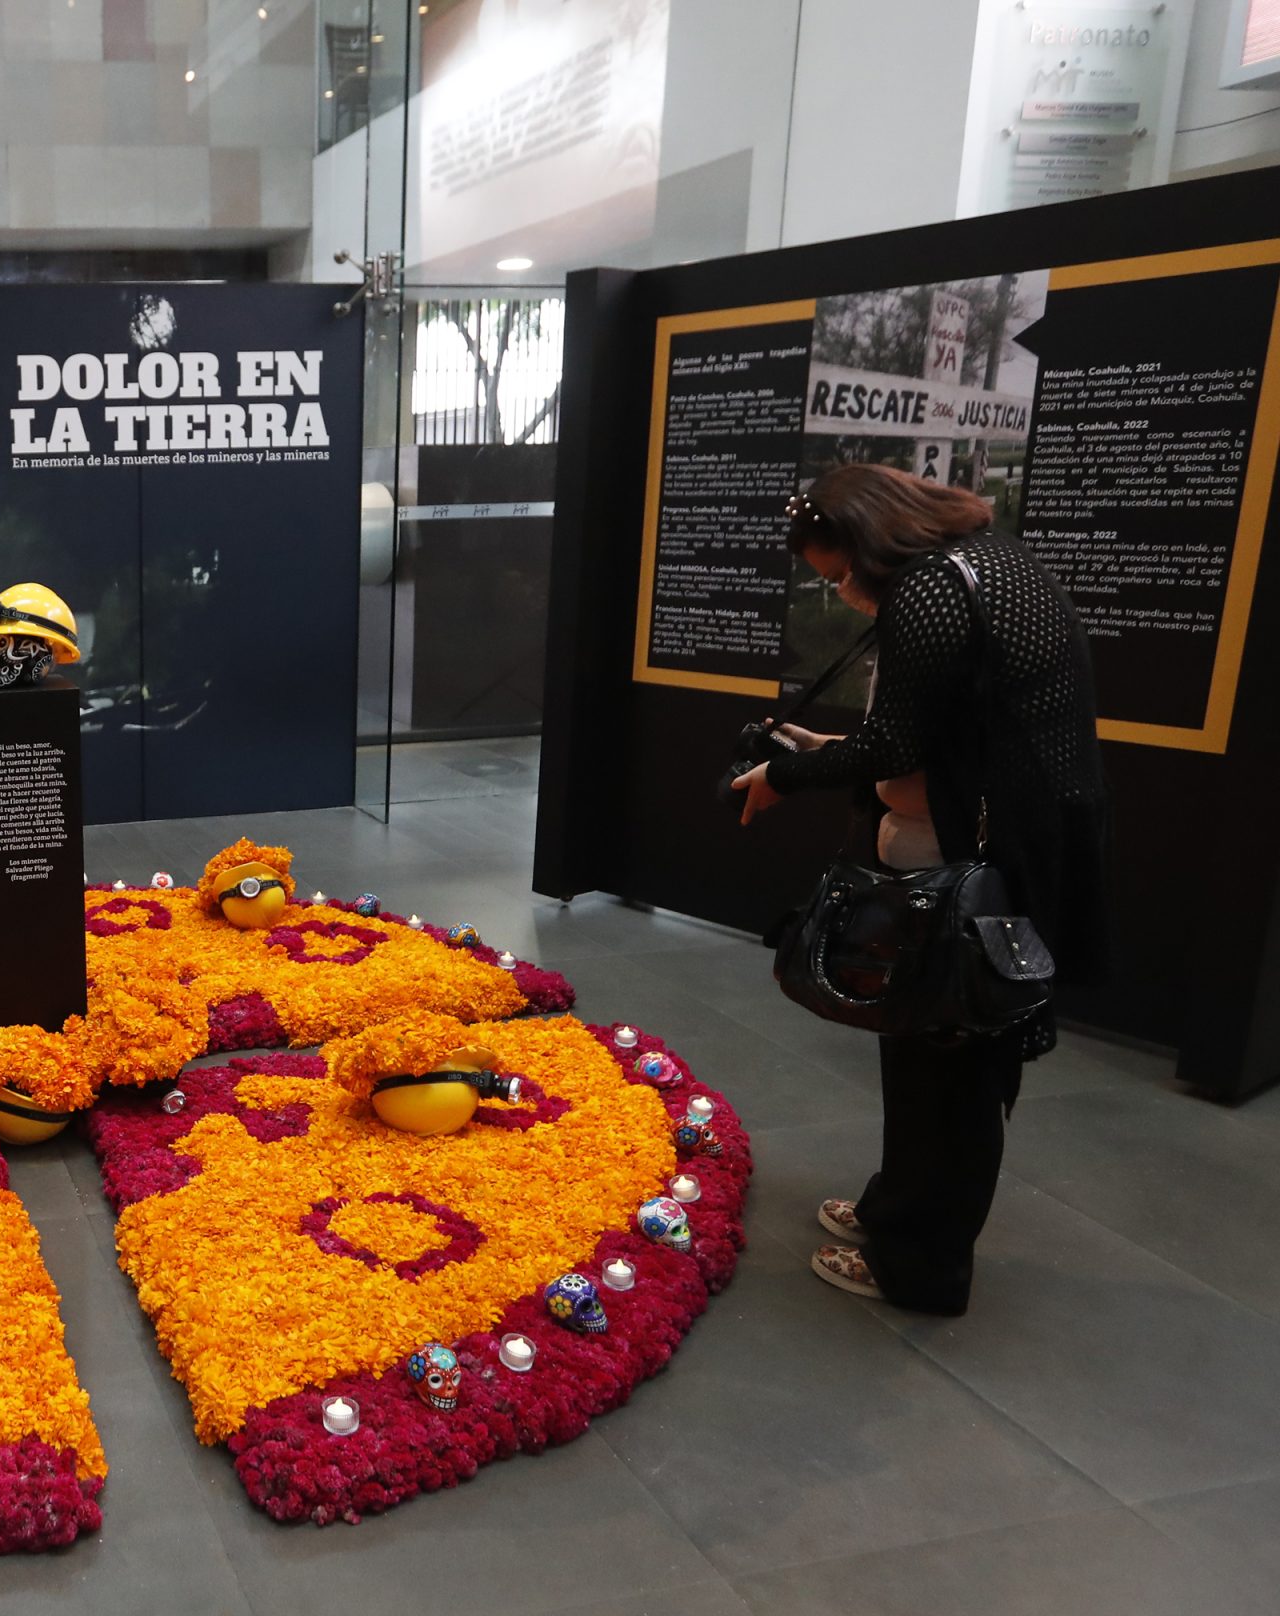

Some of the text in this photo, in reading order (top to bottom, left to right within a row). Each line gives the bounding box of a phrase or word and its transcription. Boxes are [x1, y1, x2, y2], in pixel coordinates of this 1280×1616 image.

[1029, 23, 1151, 48] Patronato
[933, 344, 956, 371] YA
[1088, 364, 1132, 375] Coahuila,
[1136, 362, 1161, 372] 2021
[16, 350, 323, 401] DOLOR EN
[1042, 381, 1060, 390] Una
[1062, 379, 1084, 388] mina
[1086, 376, 1129, 387] inundada
[1140, 372, 1190, 384] colapsada
[1192, 369, 1234, 380] condujo
[1246, 368, 1256, 376] la
[1040, 391, 1073, 400] muerte
[1077, 390, 1089, 398] de
[1094, 388, 1116, 397] siete
[1121, 386, 1159, 396] mineros
[1164, 384, 1174, 393] el
[1190, 383, 1204, 392] de
[1208, 381, 1234, 393] junio
[1240, 380, 1254, 389] de
[810, 379, 929, 425] RESCATE
[931, 400, 955, 419] 2006
[958, 399, 1027, 431] JUSTICIA
[1039, 401, 1060, 411] 2021
[1077, 400, 1086, 409] el
[1087, 398, 1133, 409] municipio
[1135, 397, 1148, 406] de
[1198, 392, 1245, 403] Coahuila.
[10, 402, 330, 454] LA TIERRA
[1037, 419, 1149, 433] Sabinas, Coahuila, 2022
[13, 448, 329, 468] En memoria de las muertes de los mineros y las mineras
[1023, 529, 1117, 541] Indé, Durango, 2022
[44, 748, 66, 756] arriba,
[39, 756, 61, 766] patrón
[31, 764, 56, 772] todavía,
[4, 774, 28, 782] abraces
[42, 772, 63, 781] puerta
[49, 779, 67, 787] mina,
[1, 820, 31, 828] comentes
[45, 817, 64, 825] arriba
[36, 826, 49, 834] vida
[50, 825, 64, 833] mía,
[52, 832, 67, 840] velas
[10, 843, 28, 851] fondo
[6, 864, 53, 873] Salvador Pliego
[11, 871, 48, 883] (fragmento)
